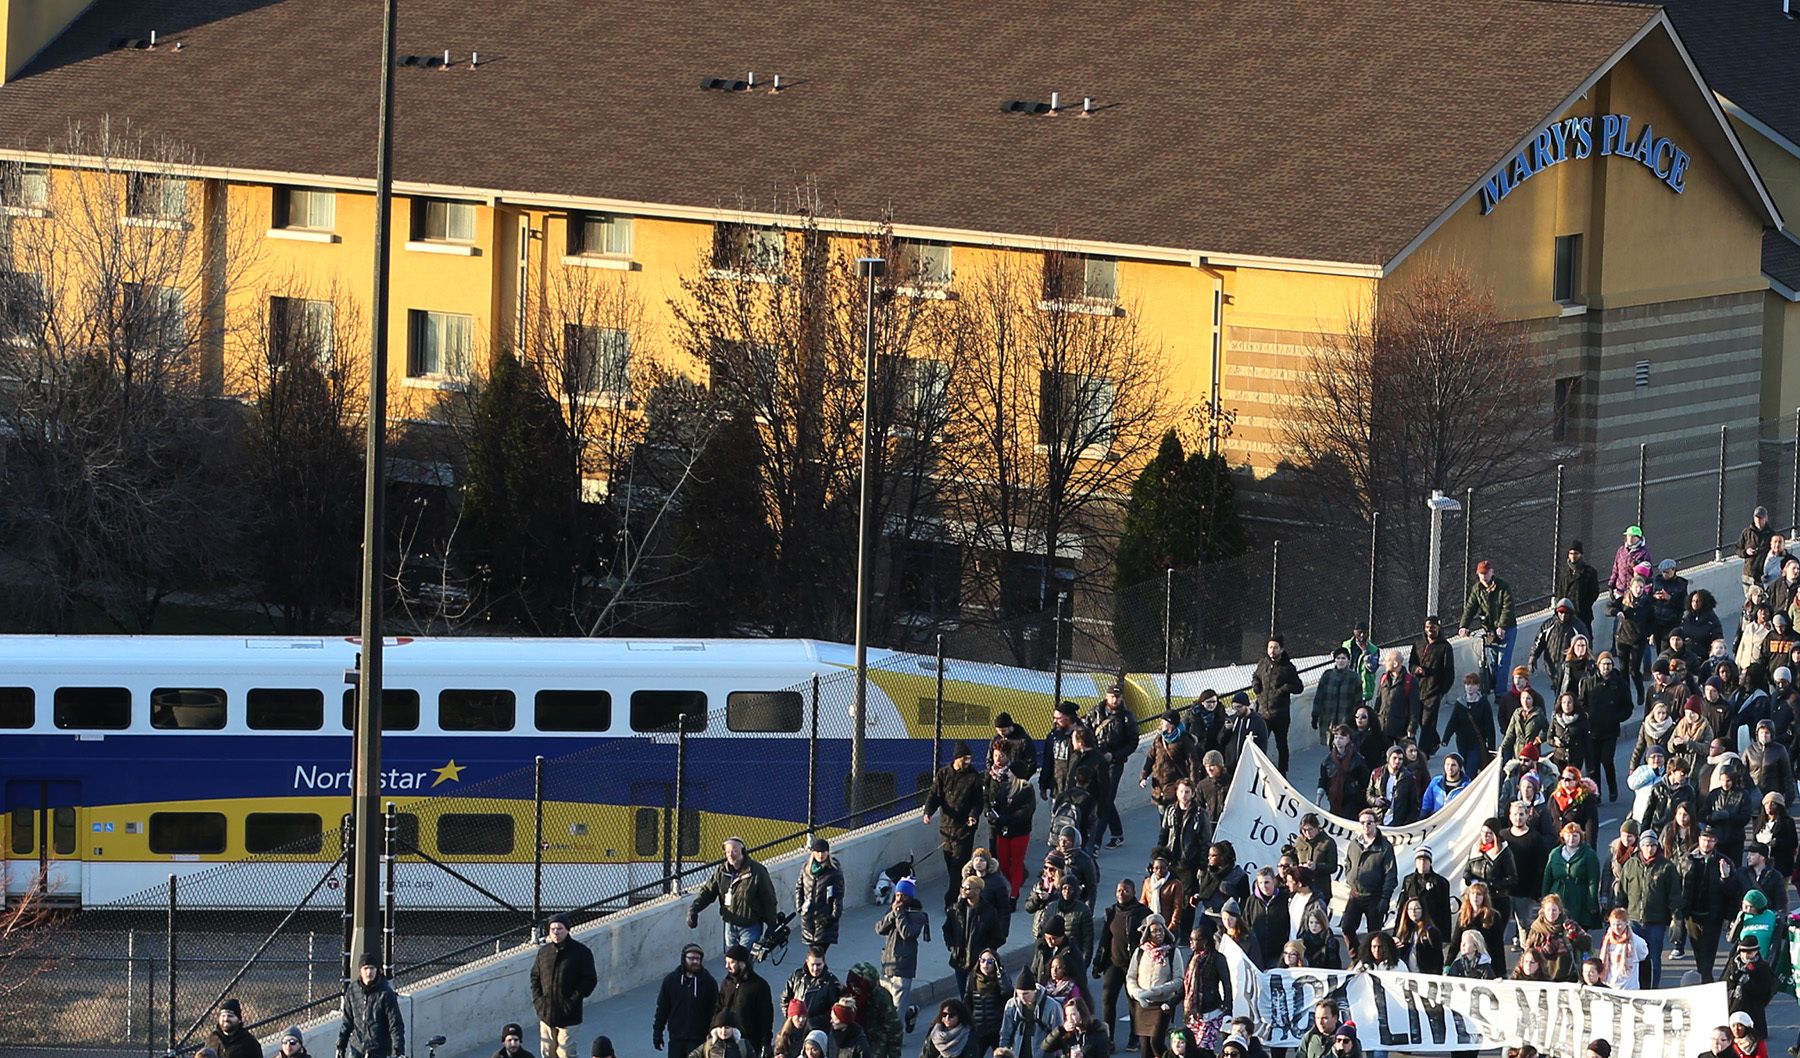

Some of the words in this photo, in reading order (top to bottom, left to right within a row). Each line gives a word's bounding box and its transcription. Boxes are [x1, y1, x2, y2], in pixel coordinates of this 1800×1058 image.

[1480, 117, 1594, 216] MARY'S
[1601, 114, 1691, 194] PLACE
[1247, 767, 1271, 800] It
[1277, 786, 1300, 819] is
[1249, 815, 1279, 846] to
[1372, 973, 1508, 1047] LIVES
